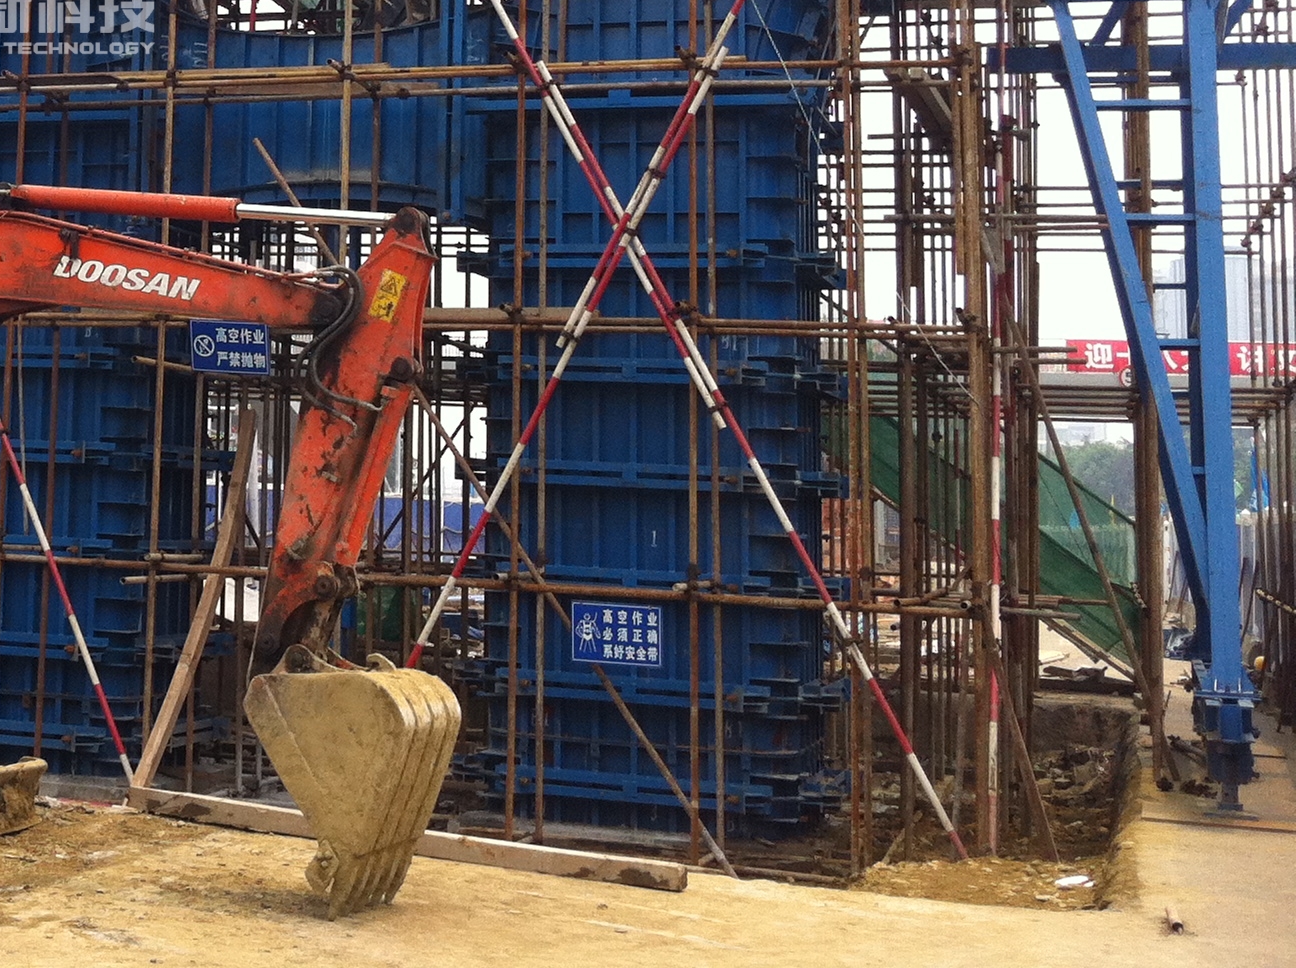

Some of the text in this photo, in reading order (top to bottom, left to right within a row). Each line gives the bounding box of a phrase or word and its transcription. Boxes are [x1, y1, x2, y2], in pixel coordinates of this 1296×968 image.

[54, 255, 202, 301] DOOSAN
[215, 326, 265, 344] 高空作业
[216, 350, 266, 369] 严禁抛物
[602, 609, 658, 627] 高空作业
[602, 627, 658, 645] 必须正确
[602, 644, 659, 662] 系好安全带
